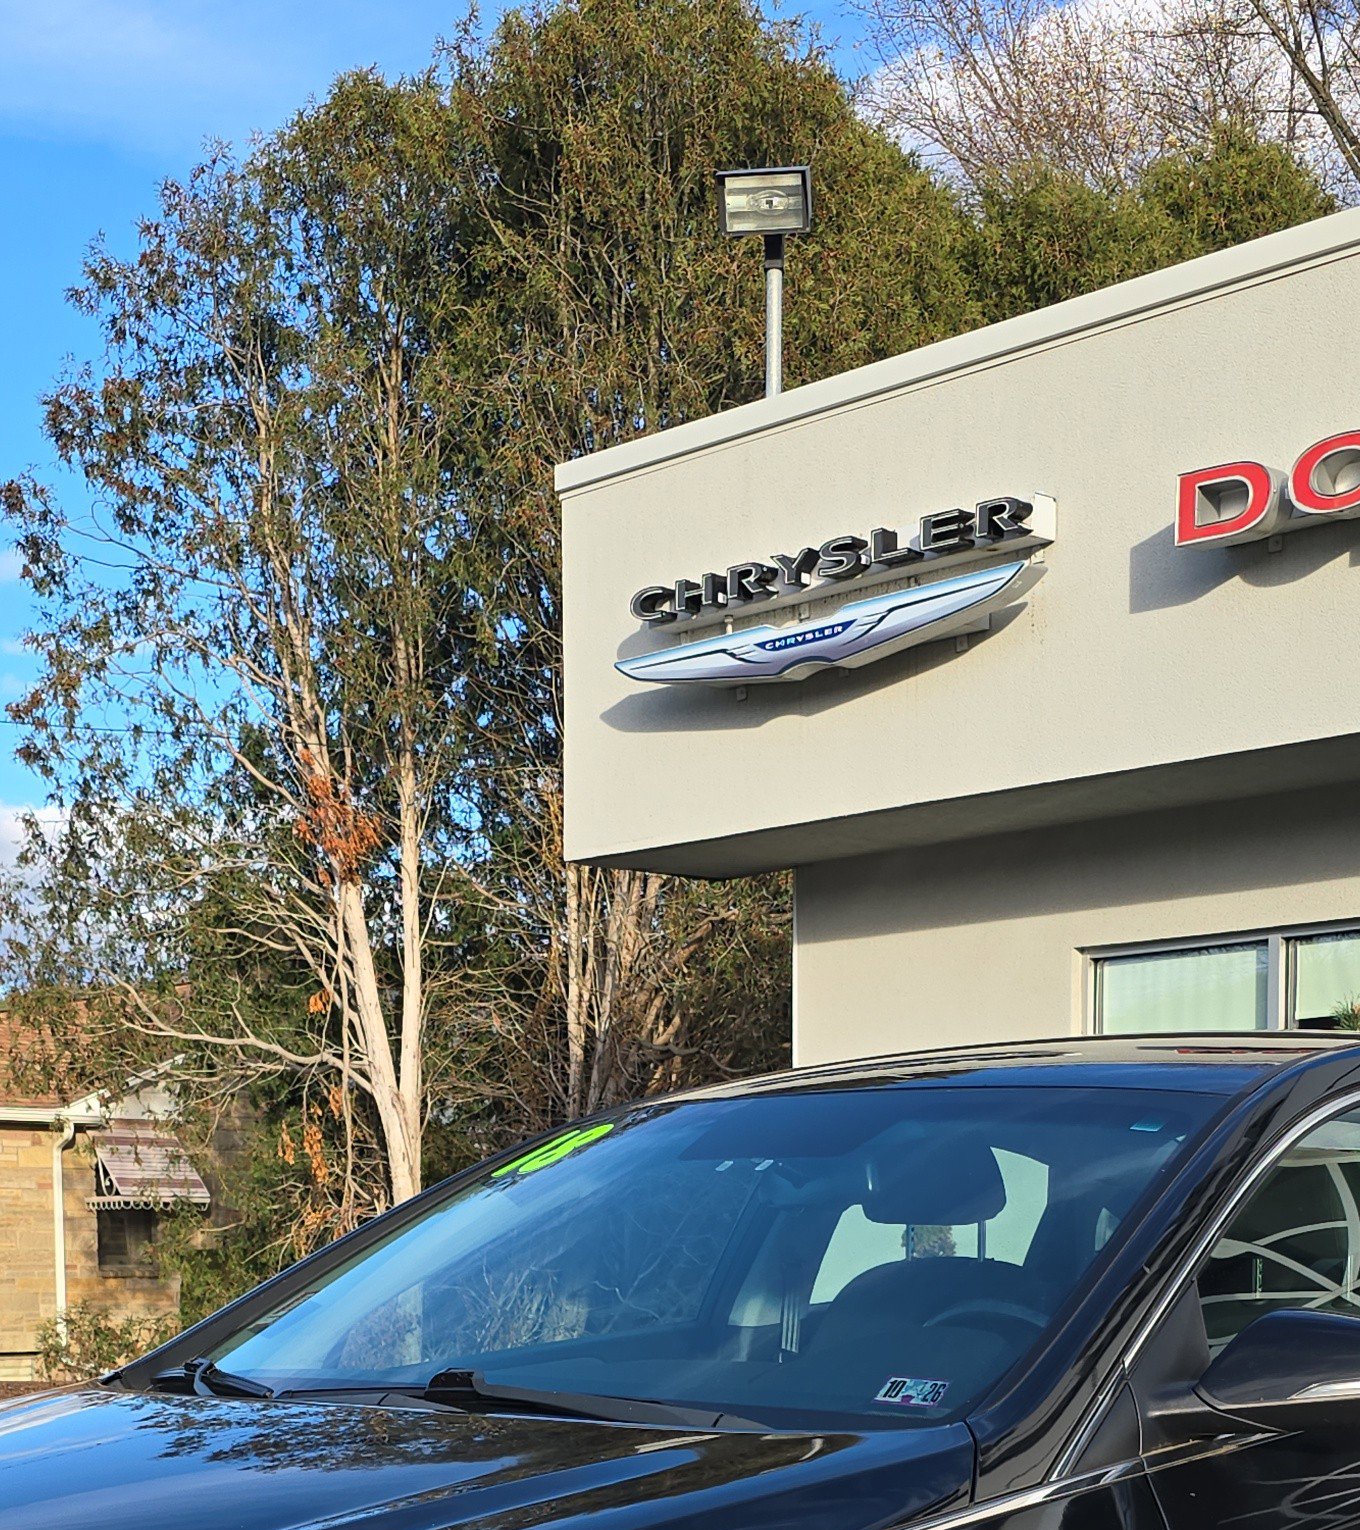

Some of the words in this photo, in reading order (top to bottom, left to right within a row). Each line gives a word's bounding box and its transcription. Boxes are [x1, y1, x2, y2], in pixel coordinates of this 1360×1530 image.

[629, 496, 1034, 622] CHRYSLER
[764, 625, 843, 650] CHRYSLER
[882, 1379, 908, 1399] 10
[920, 1382, 947, 1403] 26
